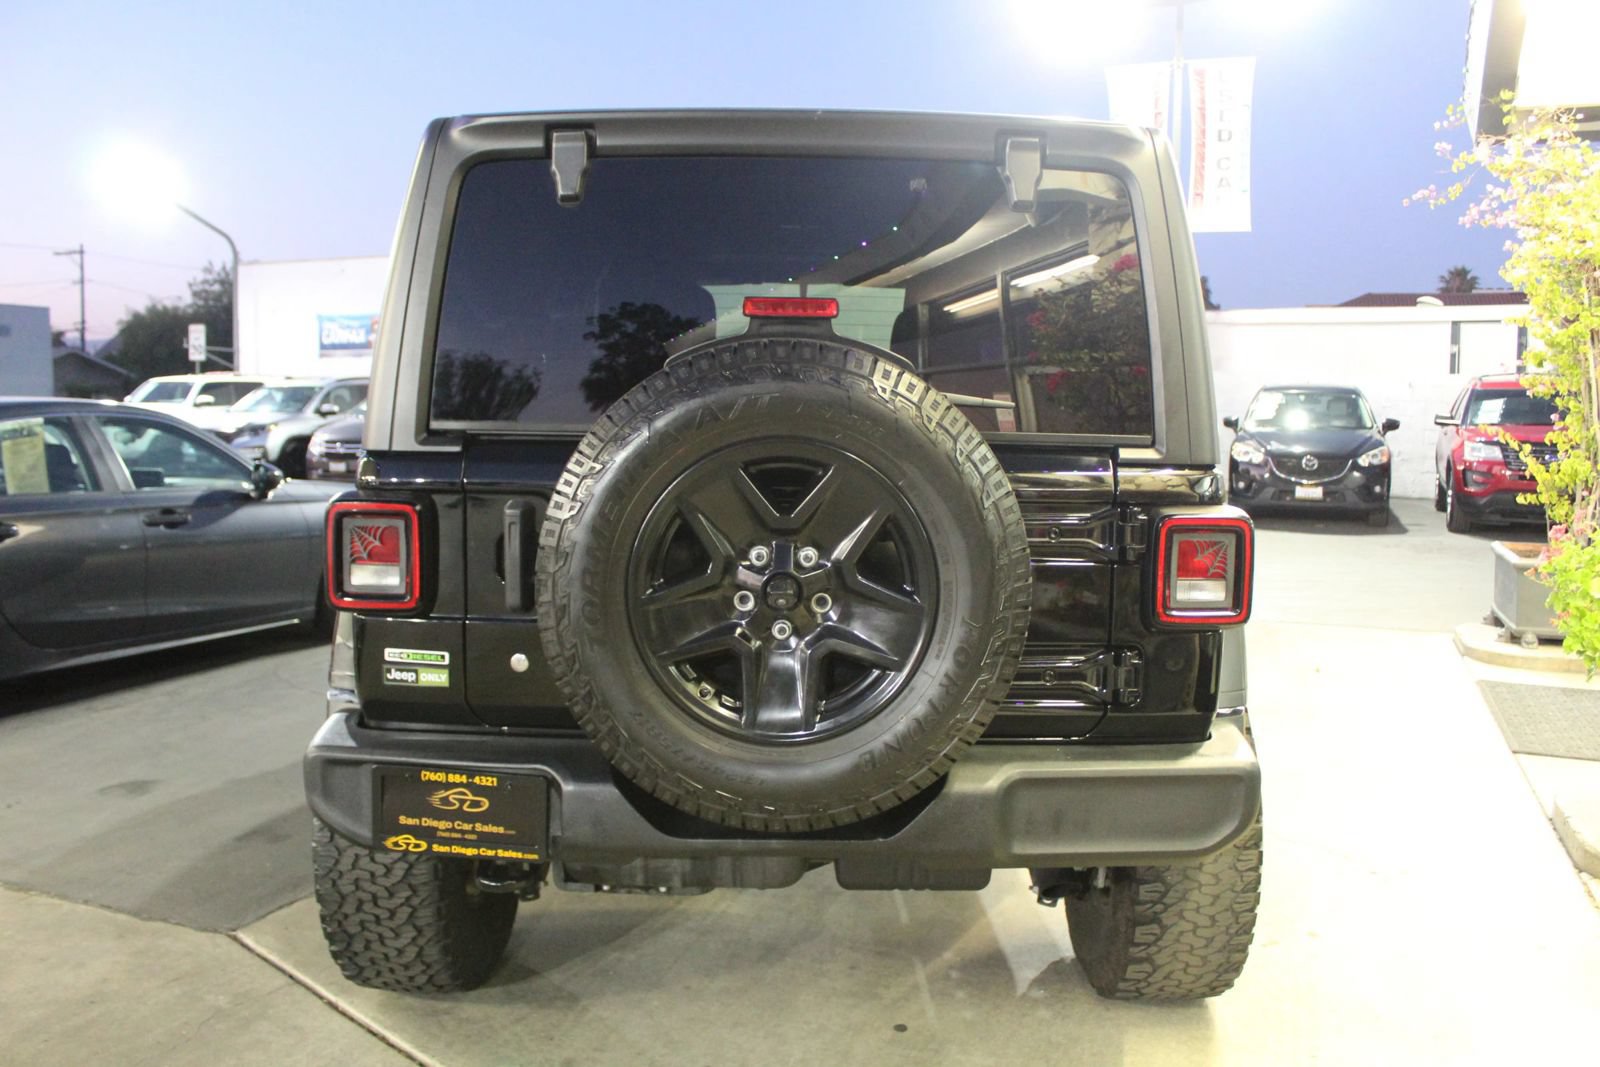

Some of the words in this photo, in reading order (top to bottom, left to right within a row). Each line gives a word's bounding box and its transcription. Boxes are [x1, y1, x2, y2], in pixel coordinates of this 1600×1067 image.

[386, 668, 416, 683] Jeep
[420, 672, 447, 682] ONLY
[421, 770, 446, 783] (760)
[447, 773, 467, 783] 884
[473, 775, 498, 786] 4321
[398, 815, 420, 826] San
[421, 817, 453, 829] Diego
[454, 821, 473, 830] Car
[431, 844, 450, 852] San
[451, 845, 478, 855] Diego
[479, 847, 496, 856] Car
